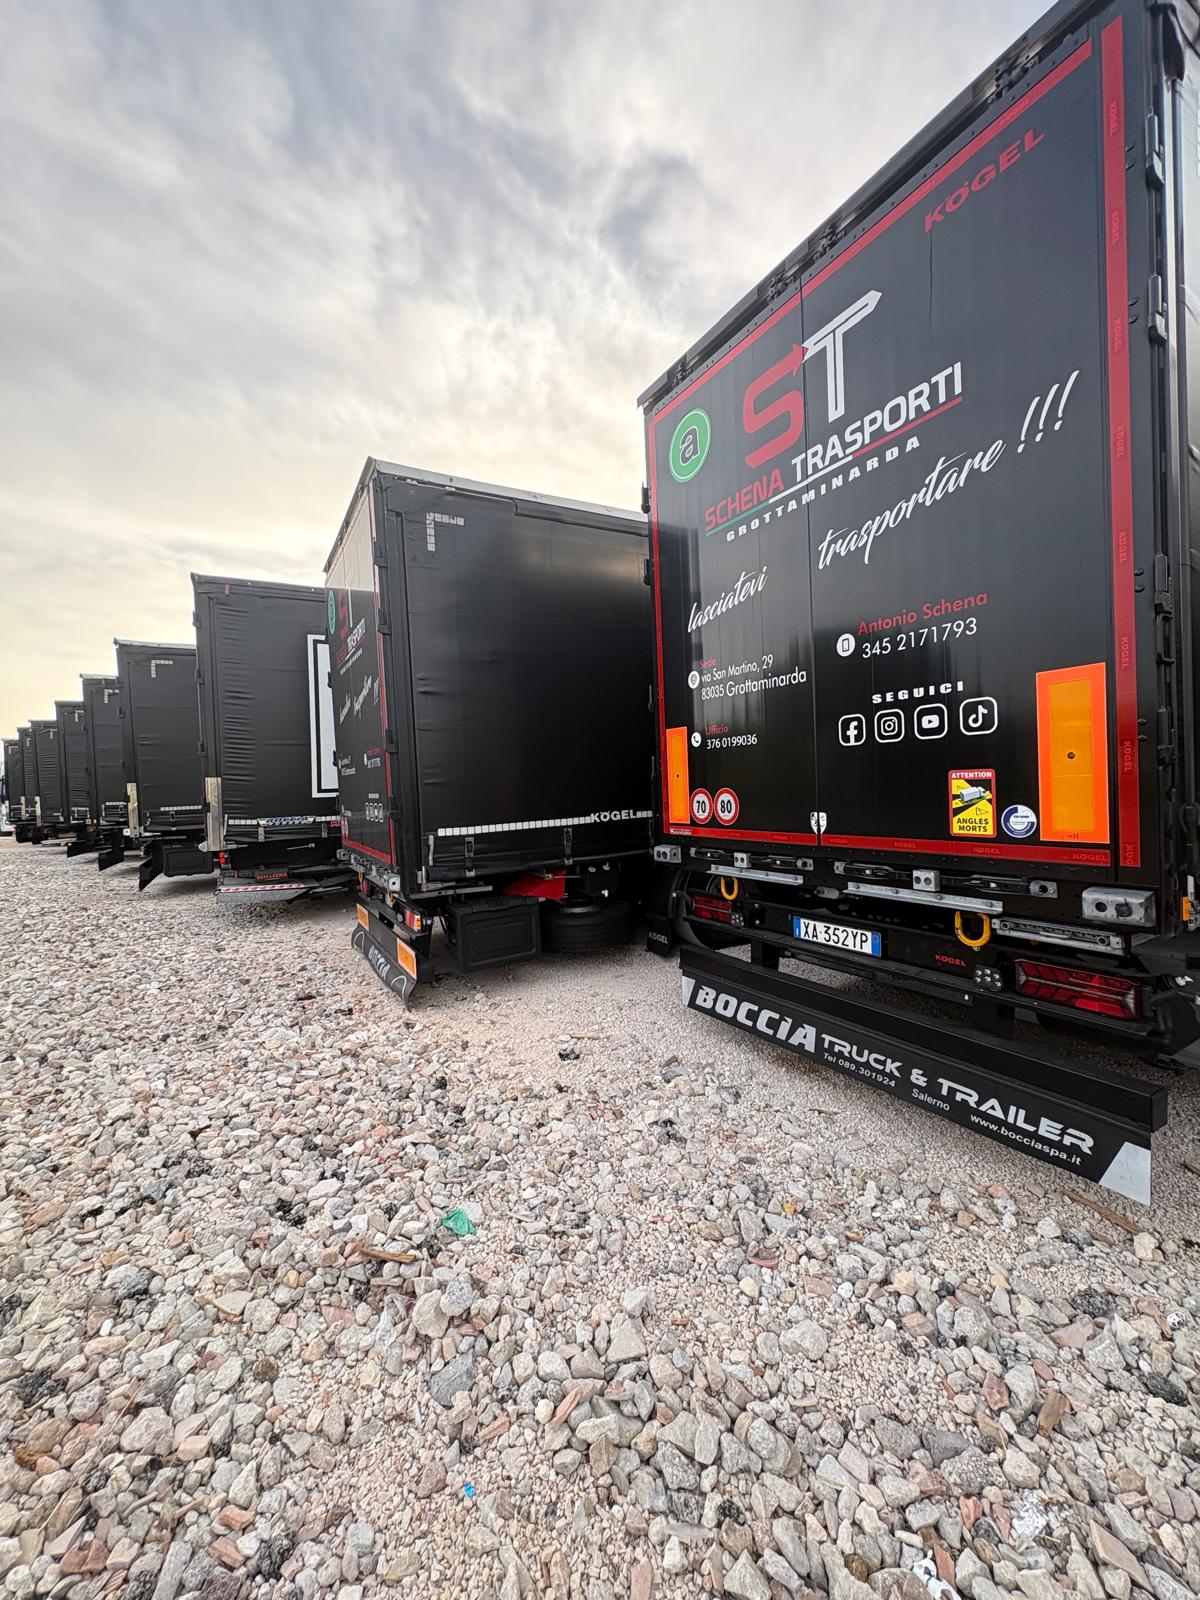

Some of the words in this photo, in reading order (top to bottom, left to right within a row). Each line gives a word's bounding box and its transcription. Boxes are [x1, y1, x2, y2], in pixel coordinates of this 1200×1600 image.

[704, 468, 785, 531] SCHENA
[791, 361, 962, 483] TRASPORTI
[726, 436, 920, 542] GROTTAMINARDA
[818, 439, 1007, 570] trasportare
[687, 566, 768, 633] lasciatevi
[857, 609, 918, 636] Antonio
[922, 592, 989, 619] Schena
[862, 637, 892, 659] 345
[897, 617, 977, 651] 2171793
[700, 656, 717, 668] Sede
[701, 670, 712, 683] via
[712, 668, 726, 681] San
[728, 660, 760, 677] Martino,
[762, 654, 774, 669] 29
[701, 684, 725, 700] 83035
[726, 666, 807, 697] Grottaminarda
[872, 681, 964, 704] SEGUICI
[705, 725, 729, 735] Ufficio
[706, 738, 721, 750] 376
[721, 734, 758, 748] 0199036
[951, 771, 992, 779] ATTENTION
[696, 800, 707, 814] 70
[720, 799, 732, 814] 80
[957, 817, 989, 825] ANGLES
[958, 825, 988, 833] MORTS
[803, 921, 819, 941] XA
[823, 925, 869, 951] 352YP
[695, 985, 817, 1053] BOCCIA
[821, 1033, 904, 1078] TRUCK
[910, 1068, 928, 1087] &
[937, 1077, 1095, 1155] TRAILER
[823, 1051, 836, 1063] Tel
[838, 1058, 896, 1087] 089.301924
[912, 1088, 951, 1112] Salerno
[970, 1113, 1082, 1166] www.bocciaspa.it
